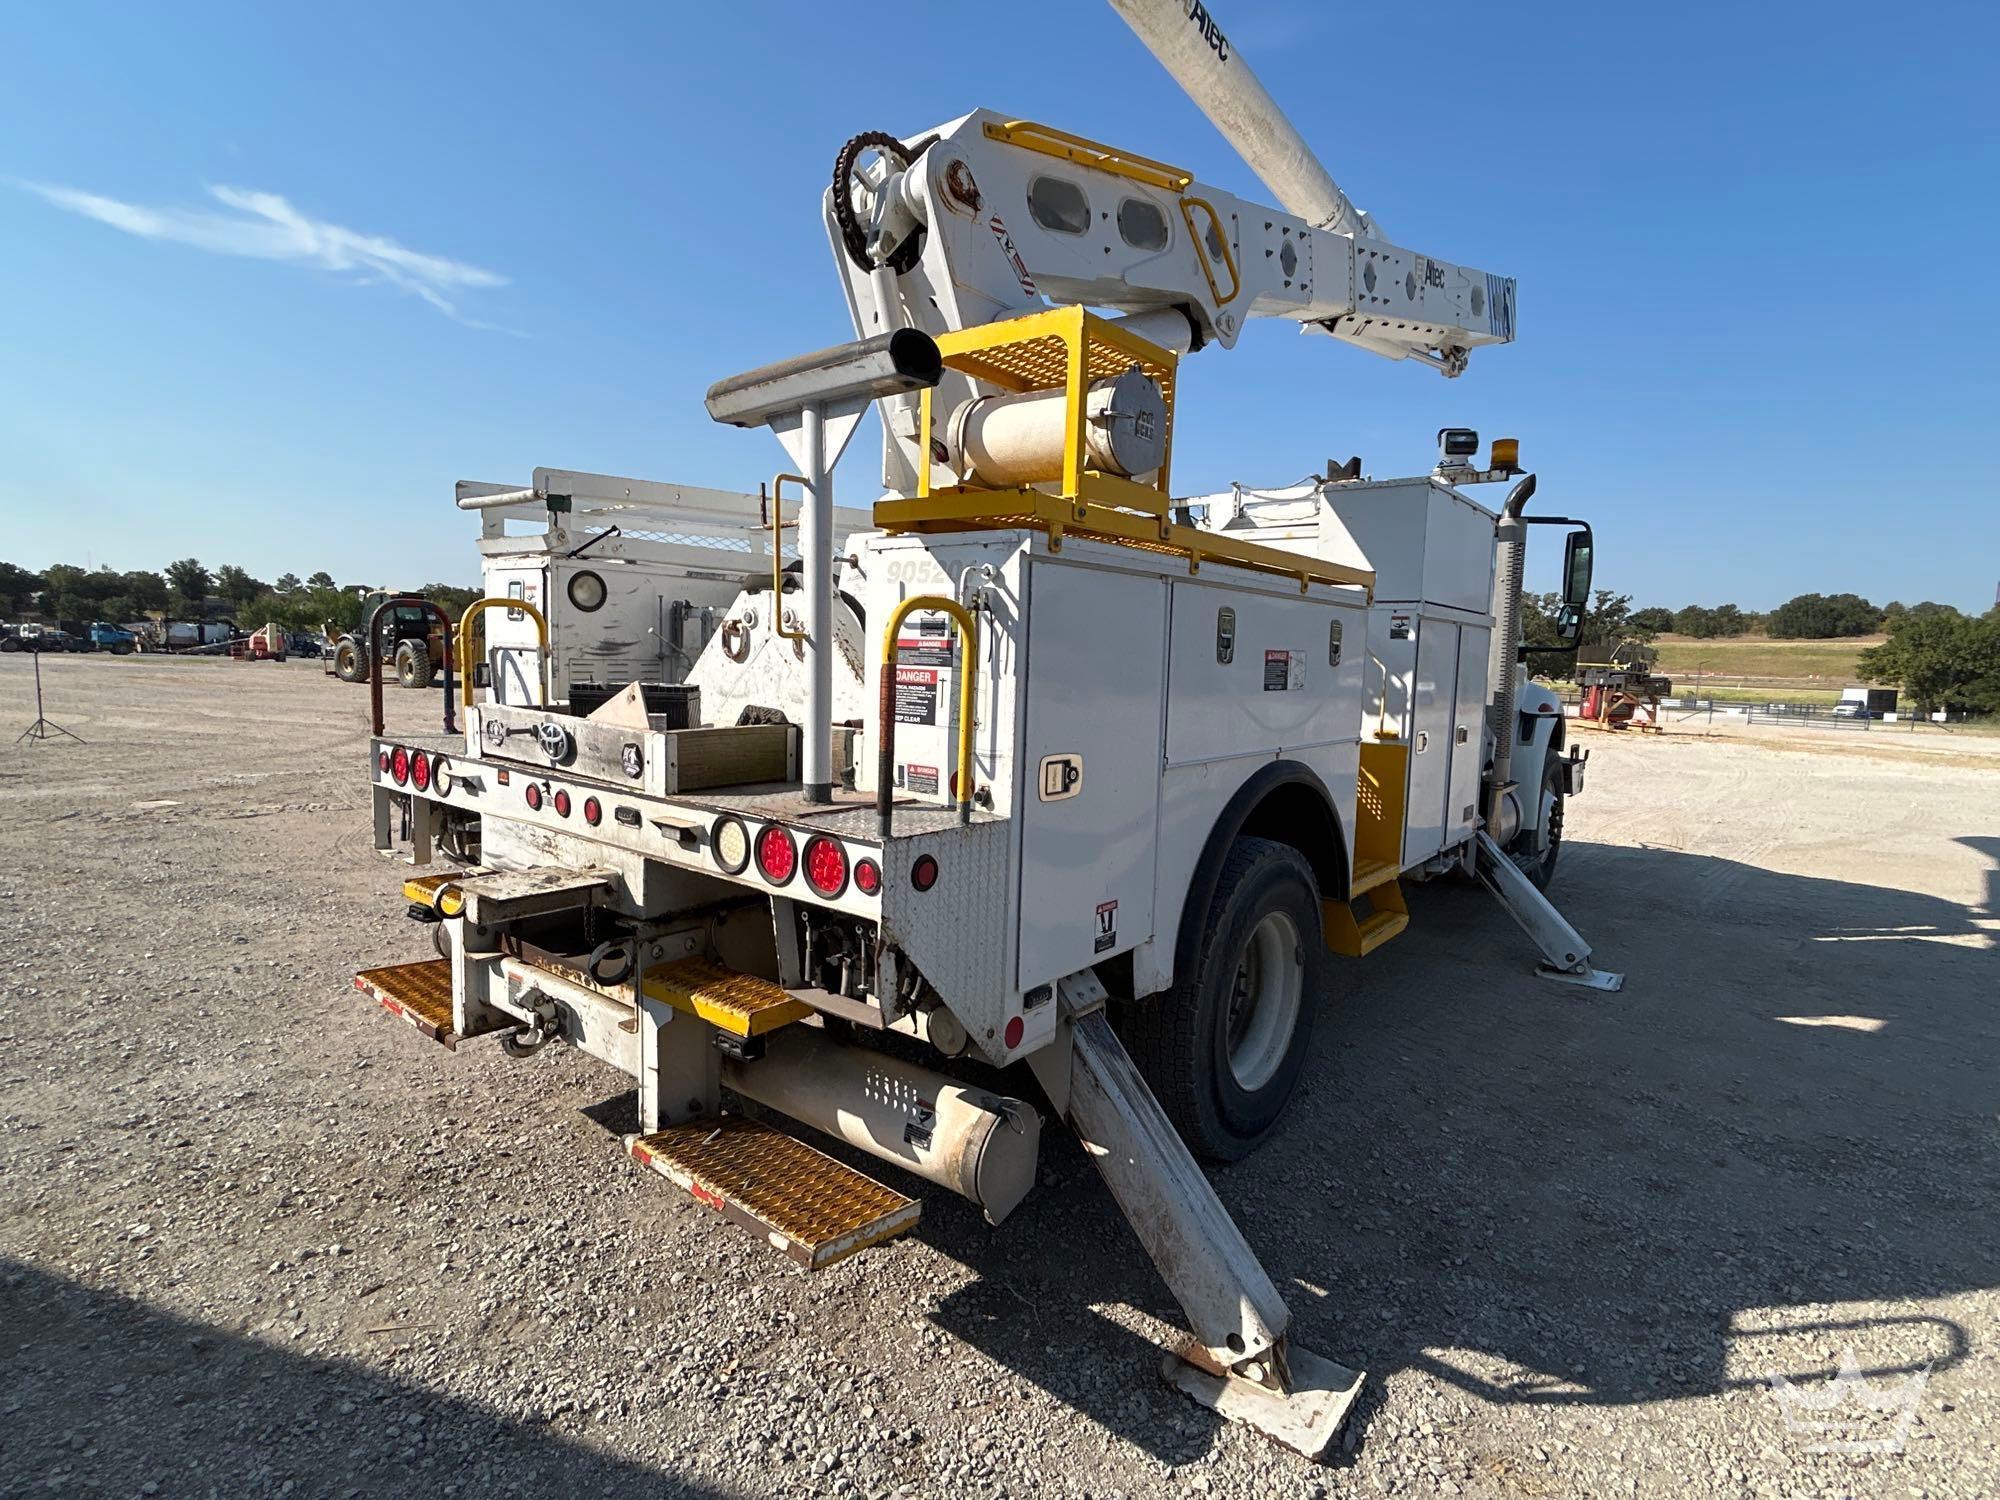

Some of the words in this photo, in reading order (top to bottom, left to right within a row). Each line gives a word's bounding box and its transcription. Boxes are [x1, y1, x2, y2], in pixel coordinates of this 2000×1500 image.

[1189, 0, 1230, 61] Altec
[1424, 259, 1445, 289] Altec
[896, 670, 931, 682] DANGER
